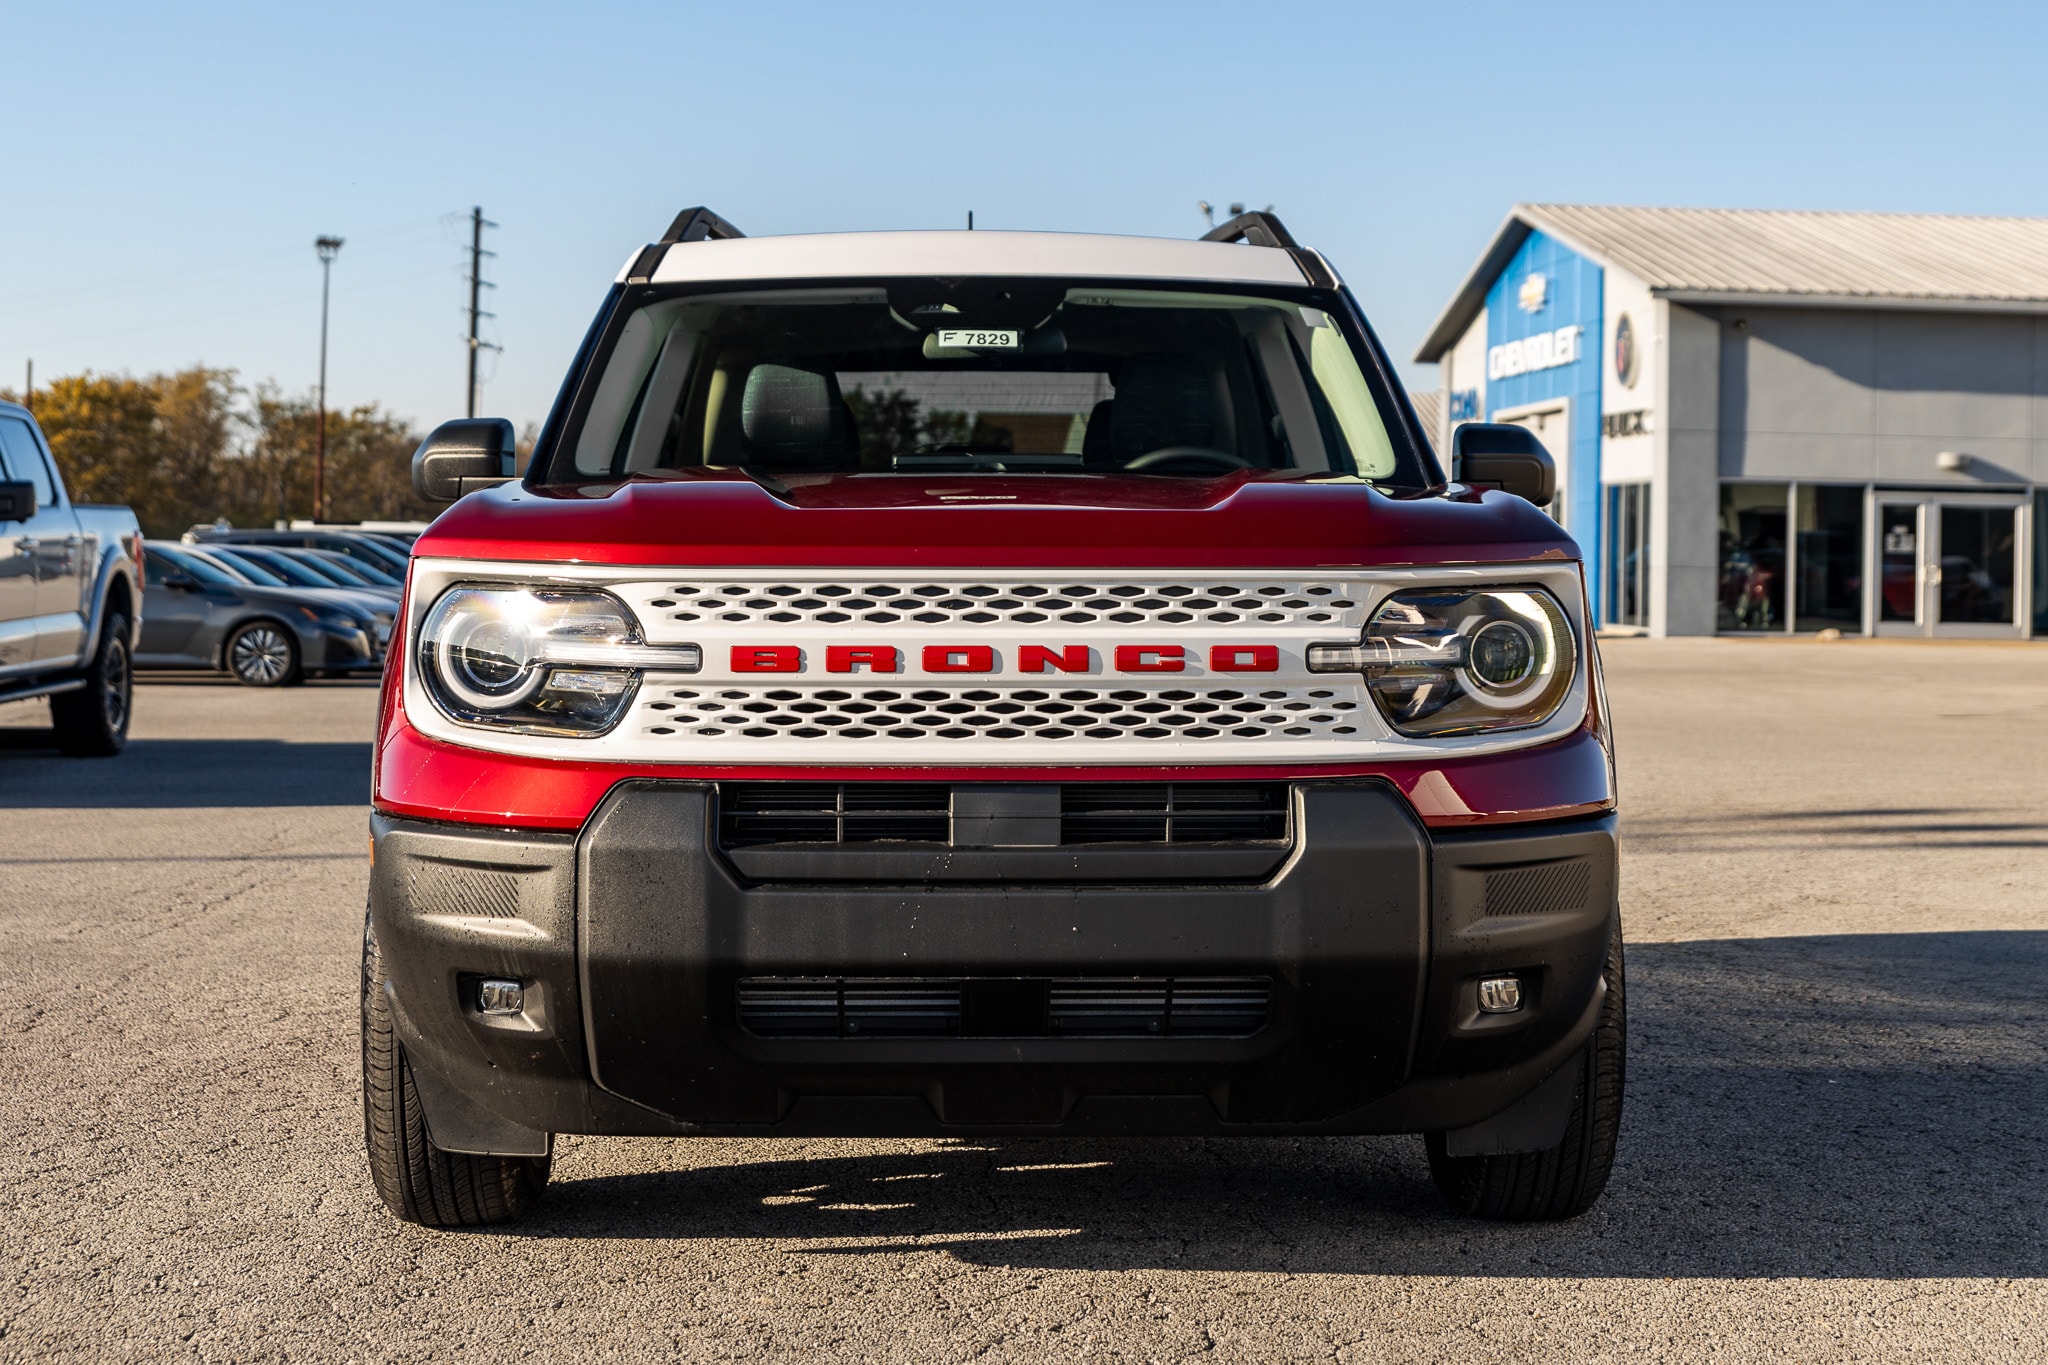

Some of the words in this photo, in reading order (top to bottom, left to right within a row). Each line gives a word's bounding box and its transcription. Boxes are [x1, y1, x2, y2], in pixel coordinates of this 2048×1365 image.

[943, 332, 958, 342] F
[965, 333, 1010, 346] 7829
[1488, 324, 1582, 382] CHEVROLET
[729, 644, 1280, 674] BRONCO
